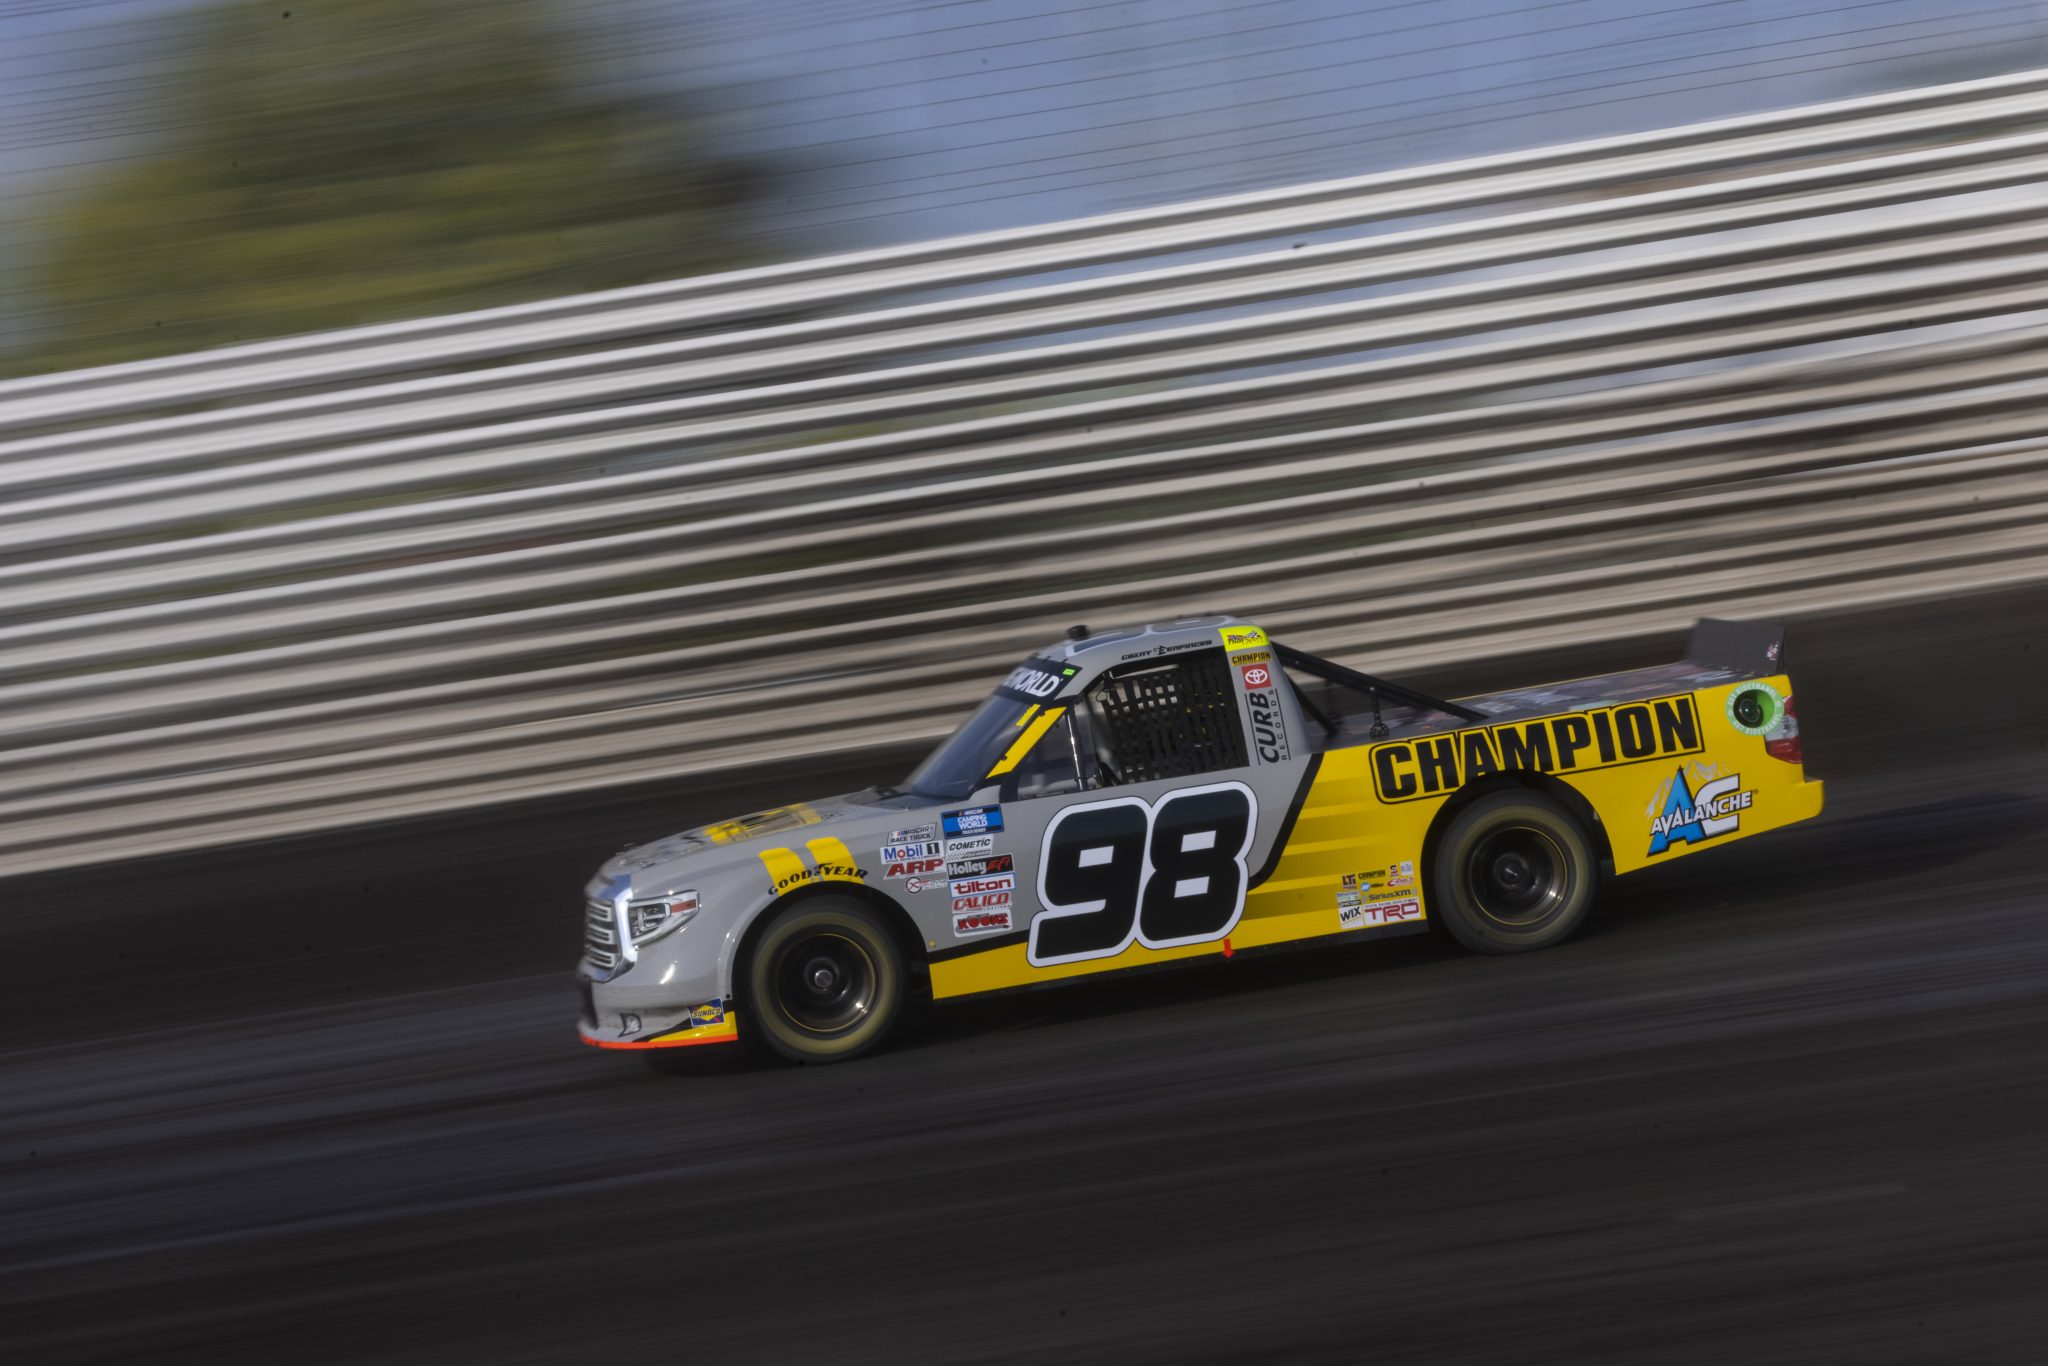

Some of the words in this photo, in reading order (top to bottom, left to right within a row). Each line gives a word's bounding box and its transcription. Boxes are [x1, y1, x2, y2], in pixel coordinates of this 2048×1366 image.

[1231, 651, 1271, 664] CHAMPION
[1249, 692, 1280, 764] CURB
[1268, 689, 1288, 761] RECORDS
[1374, 697, 1700, 800] CHAMPION
[957, 814, 988, 824] CAMPING
[1649, 789, 1753, 839] AVALANCHE
[958, 820, 989, 830] WORLD
[909, 833, 931, 841] TRUCK
[949, 839, 992, 851] COMETIC
[884, 844, 923, 861] Mobil
[886, 858, 945, 877] ARP
[947, 861, 987, 876] Holley
[1028, 782, 1257, 967] 98
[768, 863, 869, 896] GOODYEAR
[954, 879, 1012, 895] tilton
[953, 893, 1010, 912] CALICO
[1340, 906, 1362, 922] WIX
[1364, 901, 1420, 922] TRD
[691, 1006, 722, 1018] SUNOCO
